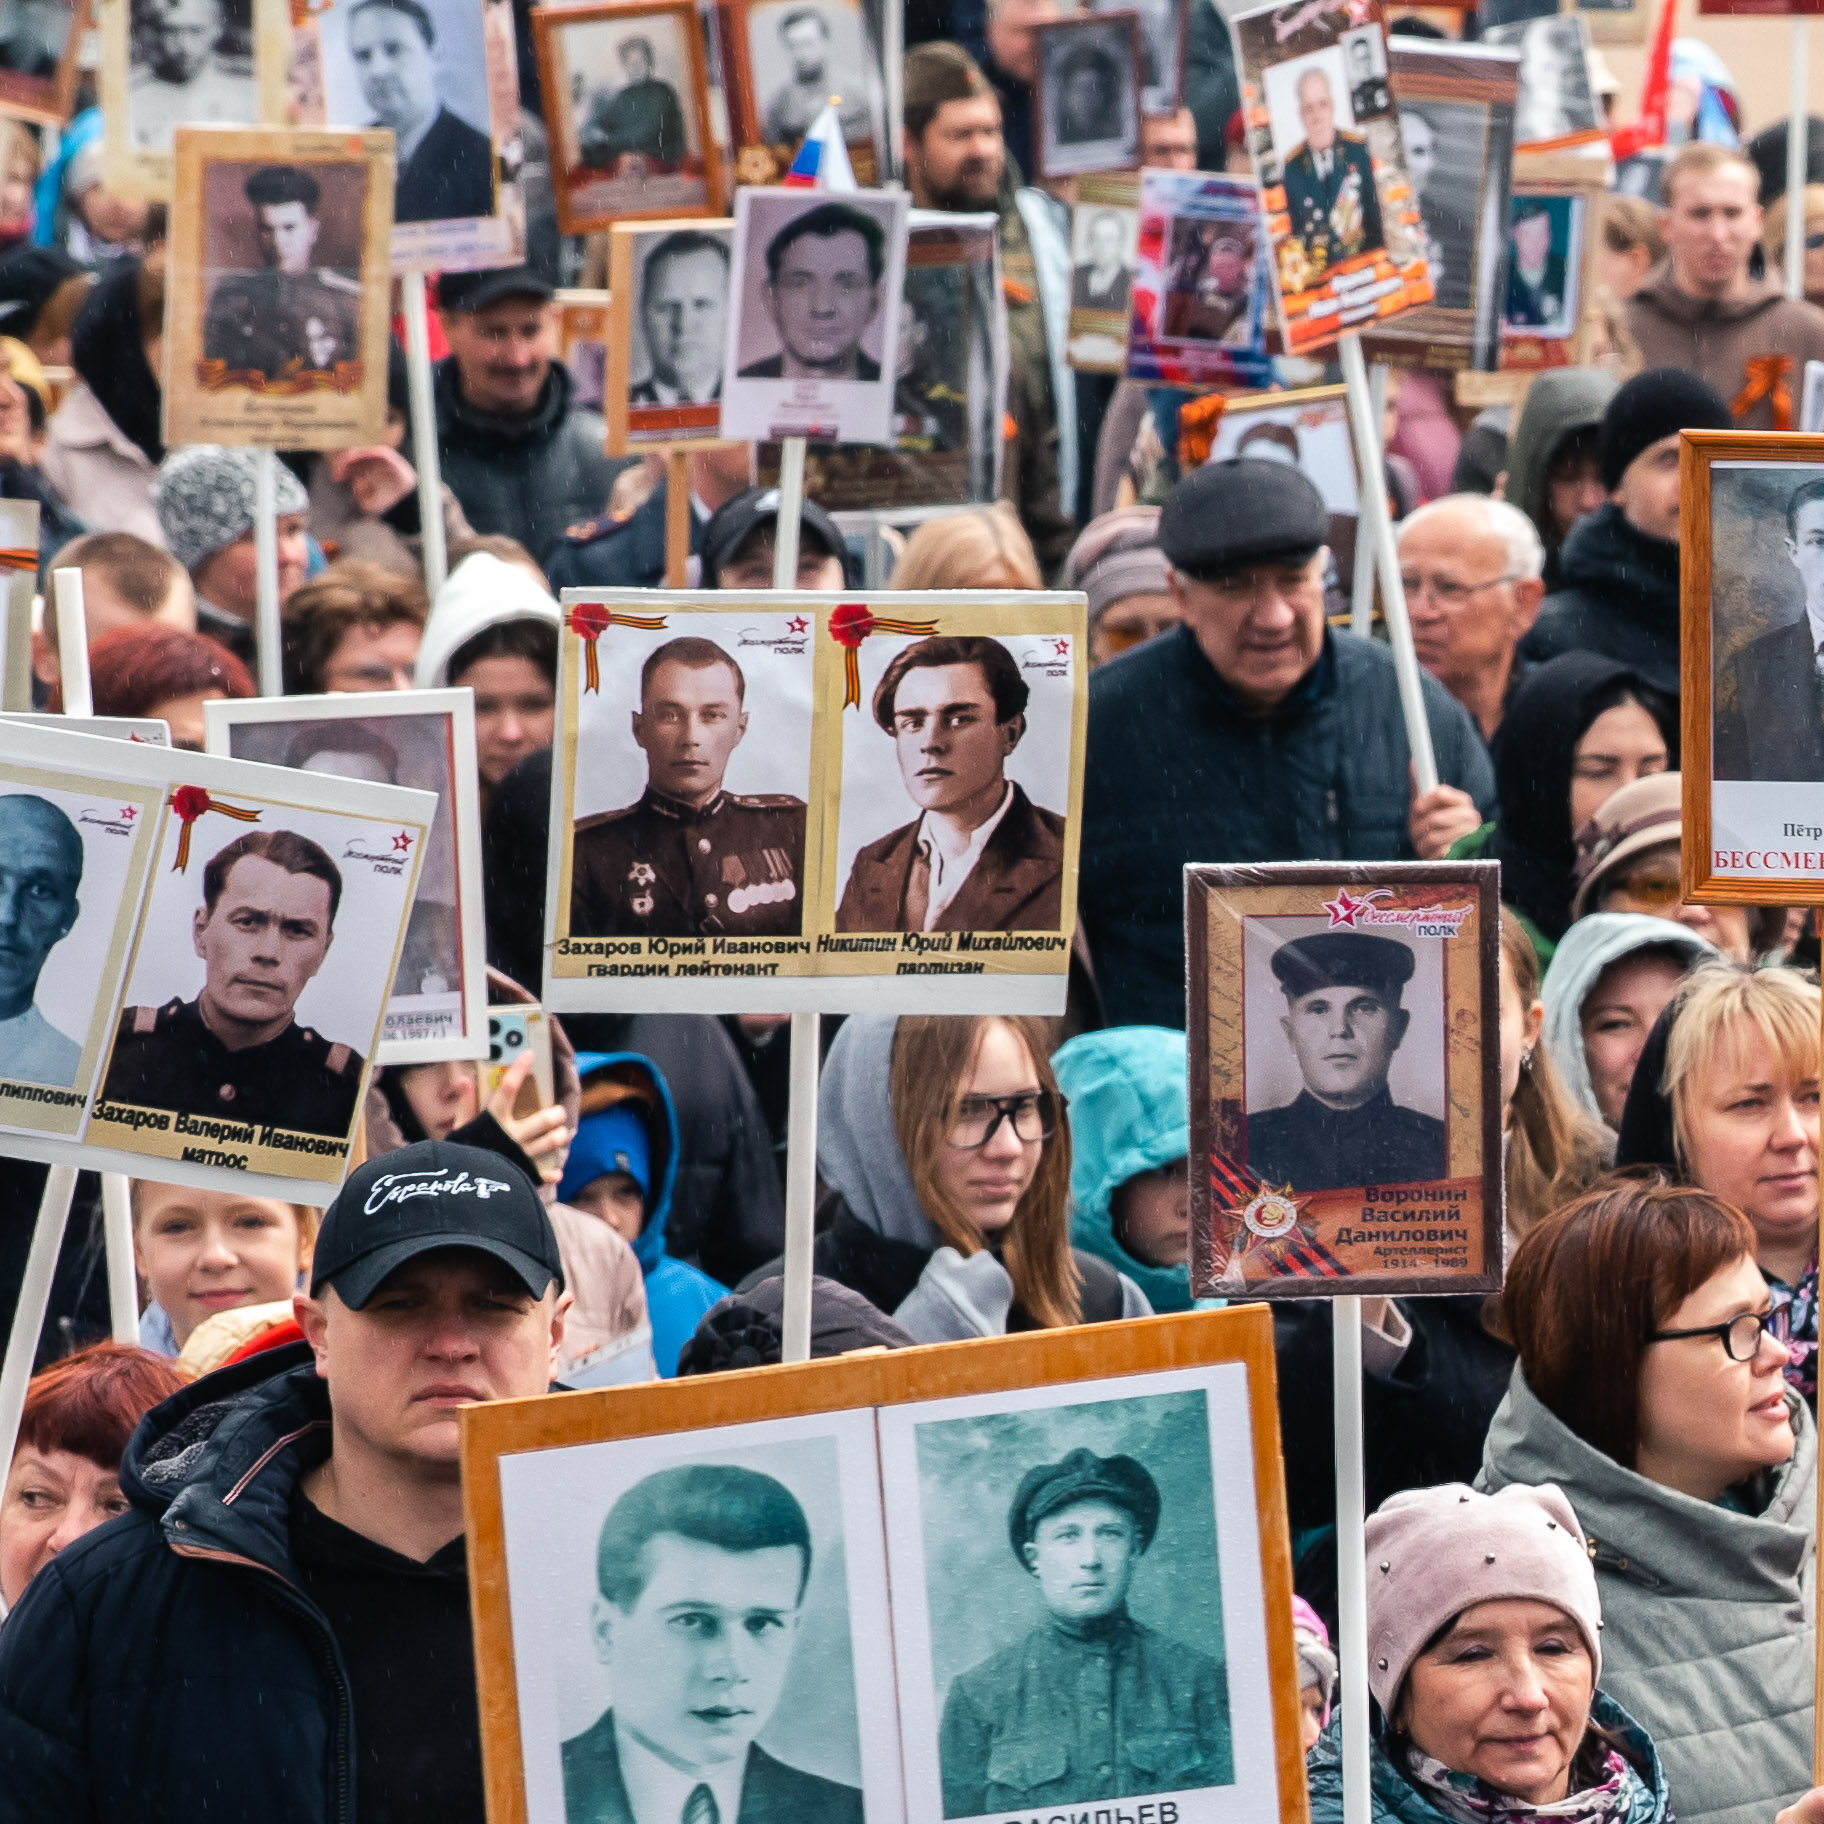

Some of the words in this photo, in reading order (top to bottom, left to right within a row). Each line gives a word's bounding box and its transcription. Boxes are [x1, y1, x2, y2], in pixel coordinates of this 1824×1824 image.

[1783, 823, 1823, 840] Пётр
[557, 937, 642, 959] Захаров
[646, 936, 706, 960] Юрий
[712, 936, 812, 956] Иванович
[816, 933, 897, 954] Никитин
[901, 931, 953, 954] Юрий
[956, 930, 1066, 954] Михайлович
[587, 960, 671, 978] гвардии
[675, 958, 779, 978] лейтенант
[92, 1101, 170, 1134] Захаров
[174, 1113, 255, 1145] Валерий
[259, 1124, 350, 1159] Иванович
[181, 1144, 249, 1171] матрос
[1366, 1187, 1467, 1206] Воронин
[1361, 1206, 1460, 1223] Василий
[1335, 1227, 1468, 1246] Данилович
[1373, 1245, 1468, 1258] Артеллерист
